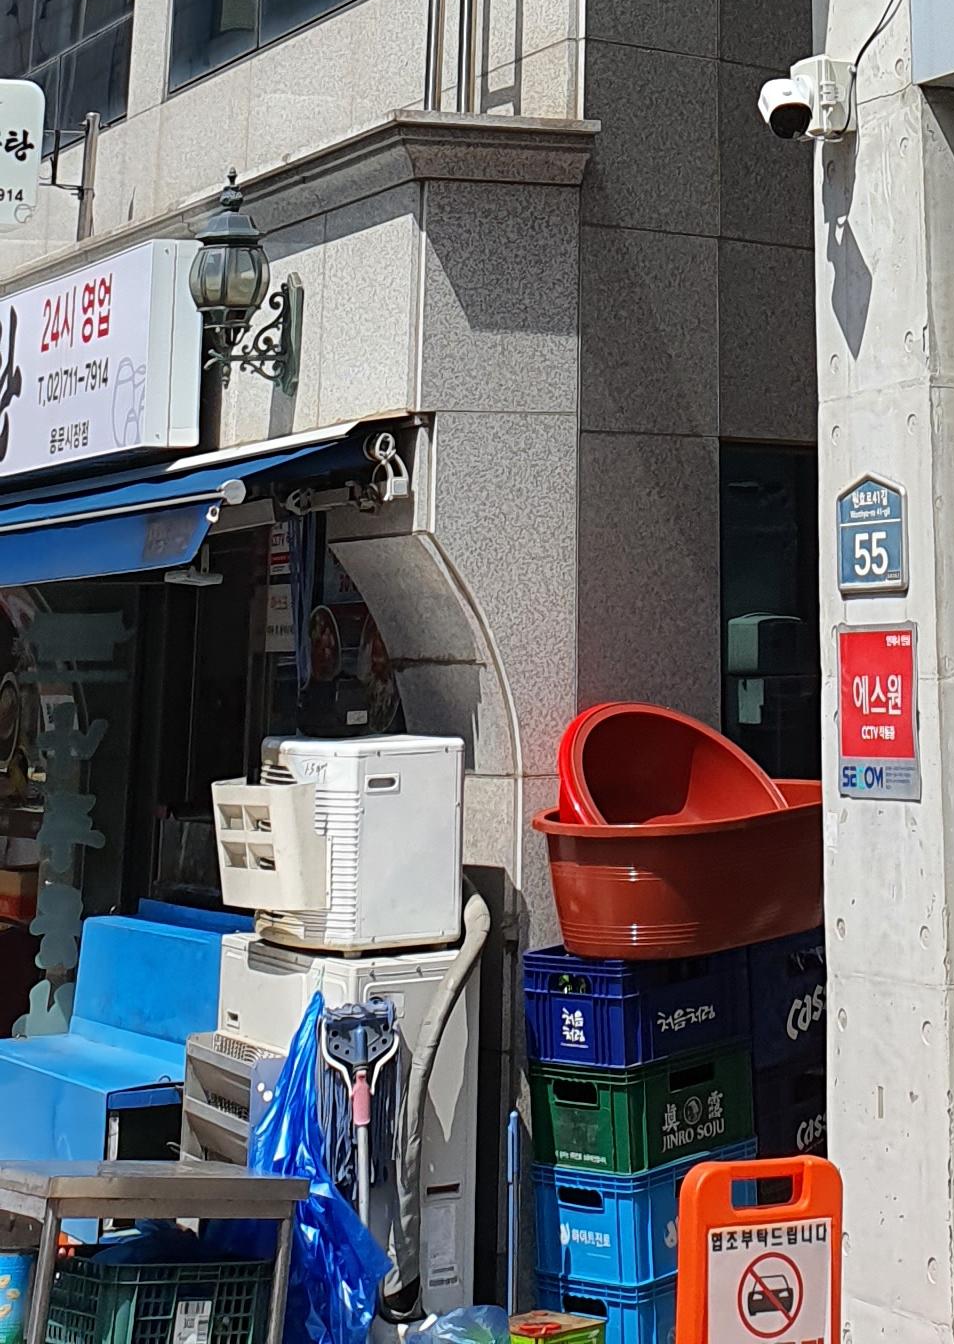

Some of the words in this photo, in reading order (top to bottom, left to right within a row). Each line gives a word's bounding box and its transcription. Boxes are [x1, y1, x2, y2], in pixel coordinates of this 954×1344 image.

[0, 128, 35, 162] 탕
[40, 285, 77, 353] 24시
[81, 272, 113, 344] 영업
[854, 531, 888, 576] 55
[852, 674, 902, 716] 에스원
[861, 725, 878, 740] CCTV
[842, 765, 884, 790] SECOM
[661, 1127, 695, 1153] JINRO
[696, 1118, 726, 1140] SOJU
